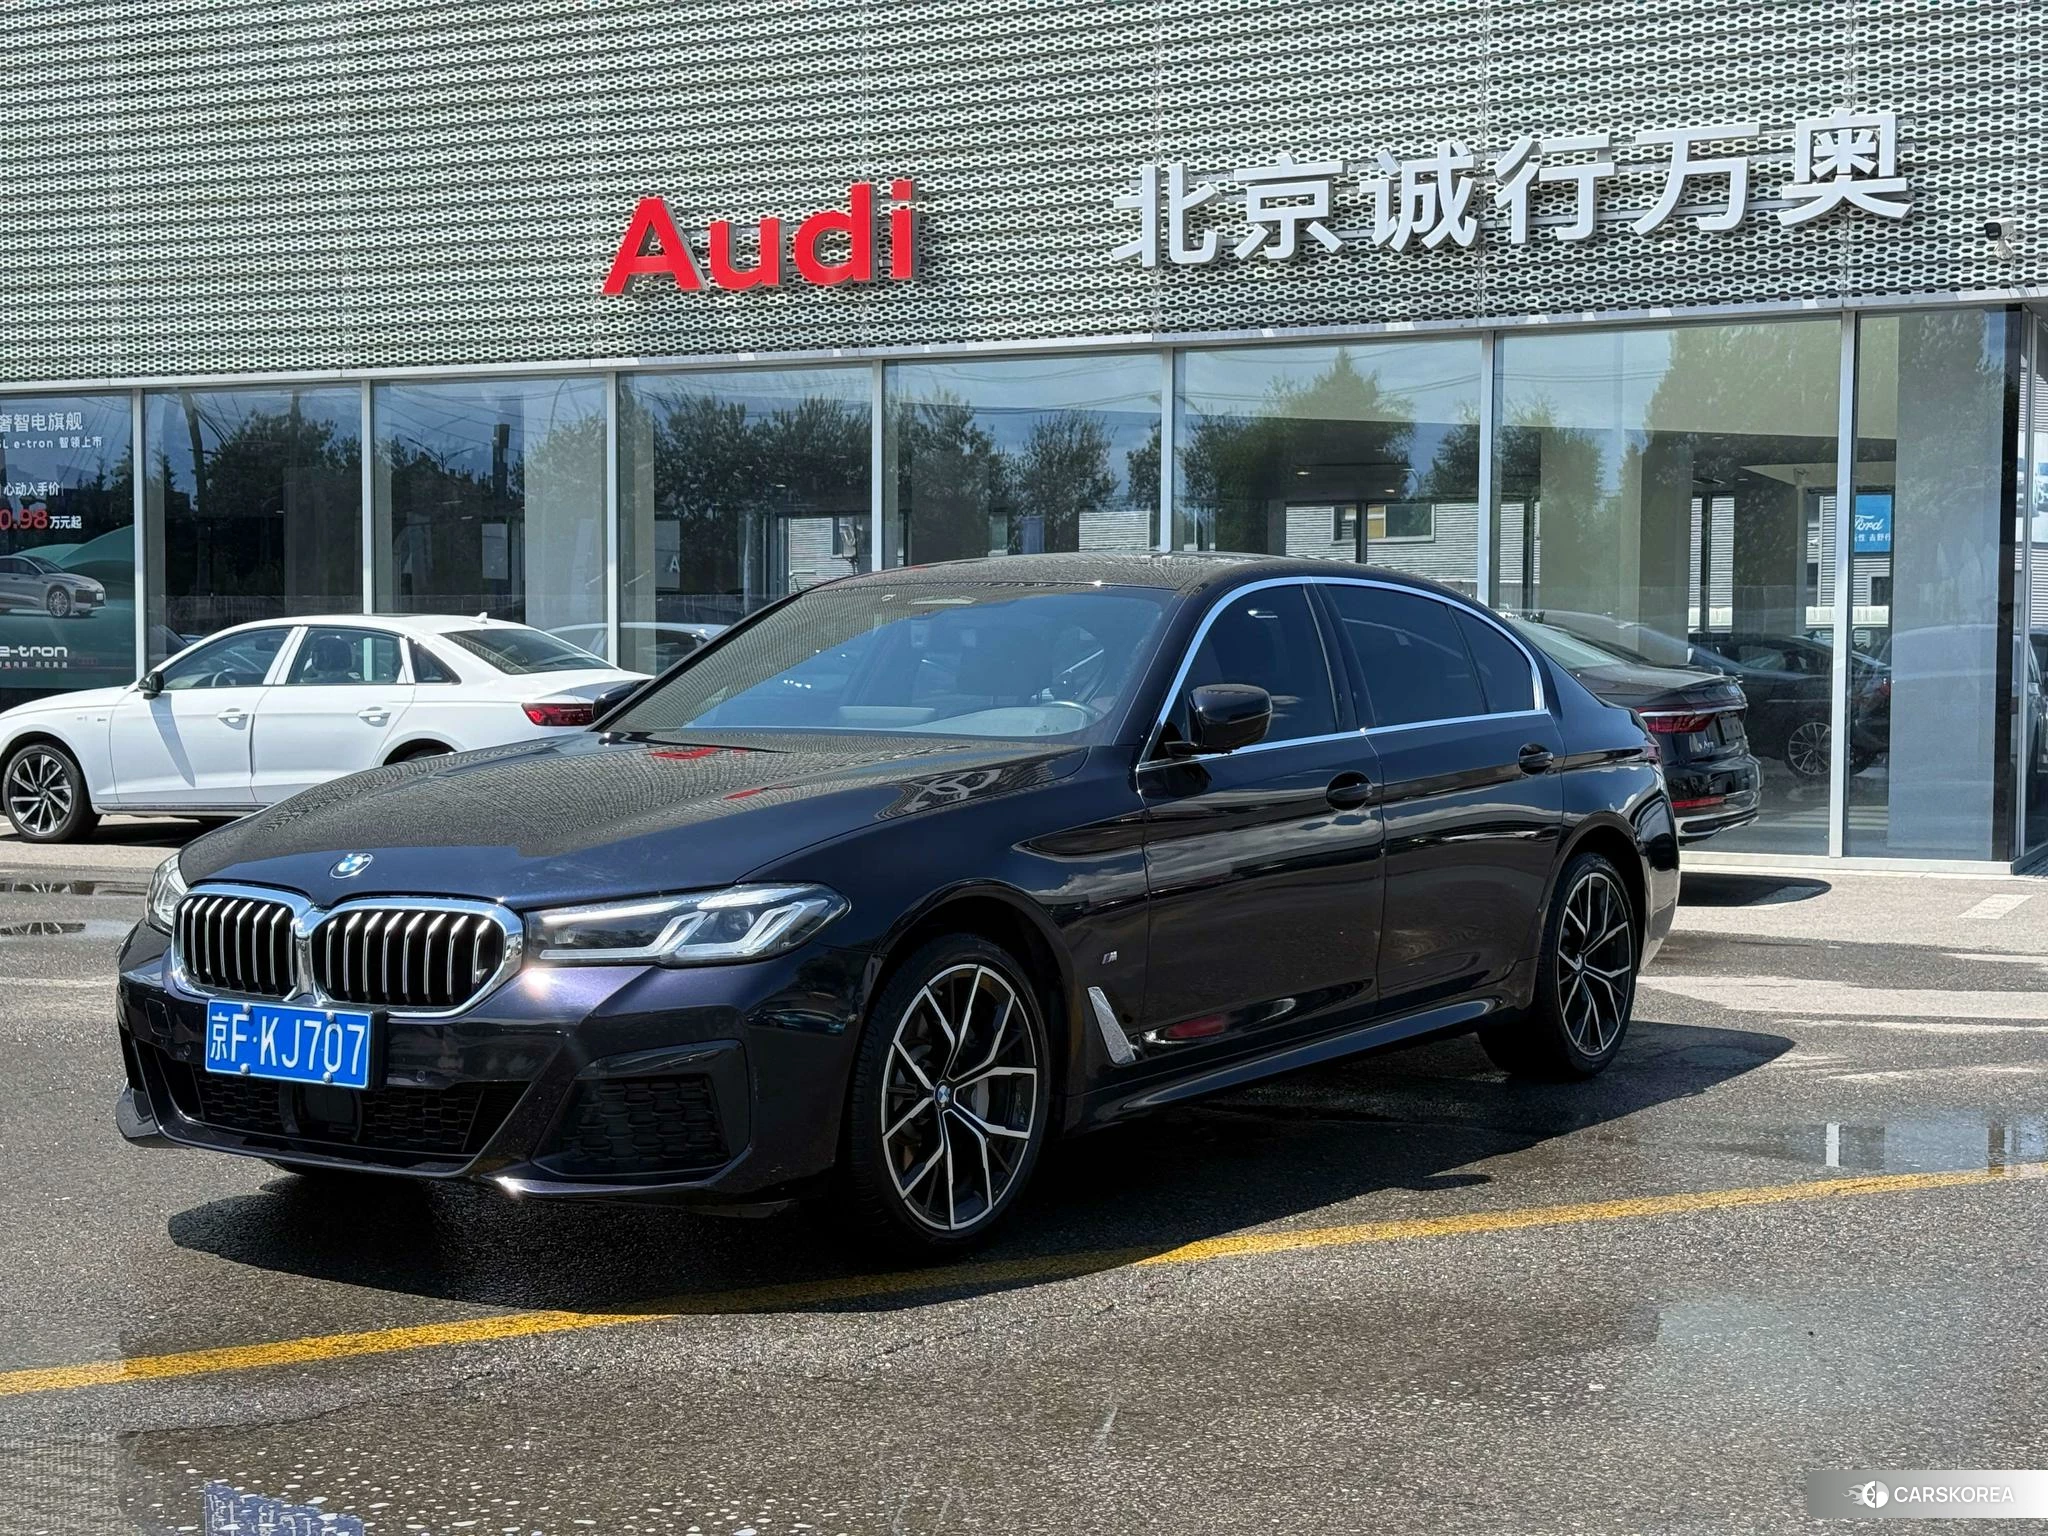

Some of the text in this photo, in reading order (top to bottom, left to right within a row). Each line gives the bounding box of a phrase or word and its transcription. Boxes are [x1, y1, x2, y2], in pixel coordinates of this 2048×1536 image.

[1112, 108, 1913, 268] 北京诚行万奥
[602, 180, 914, 295] Audi
[14, 439, 54, 449] e-tron
[3, 482, 60, 497] 心动入手价
[49, 515, 82, 529] 万元起
